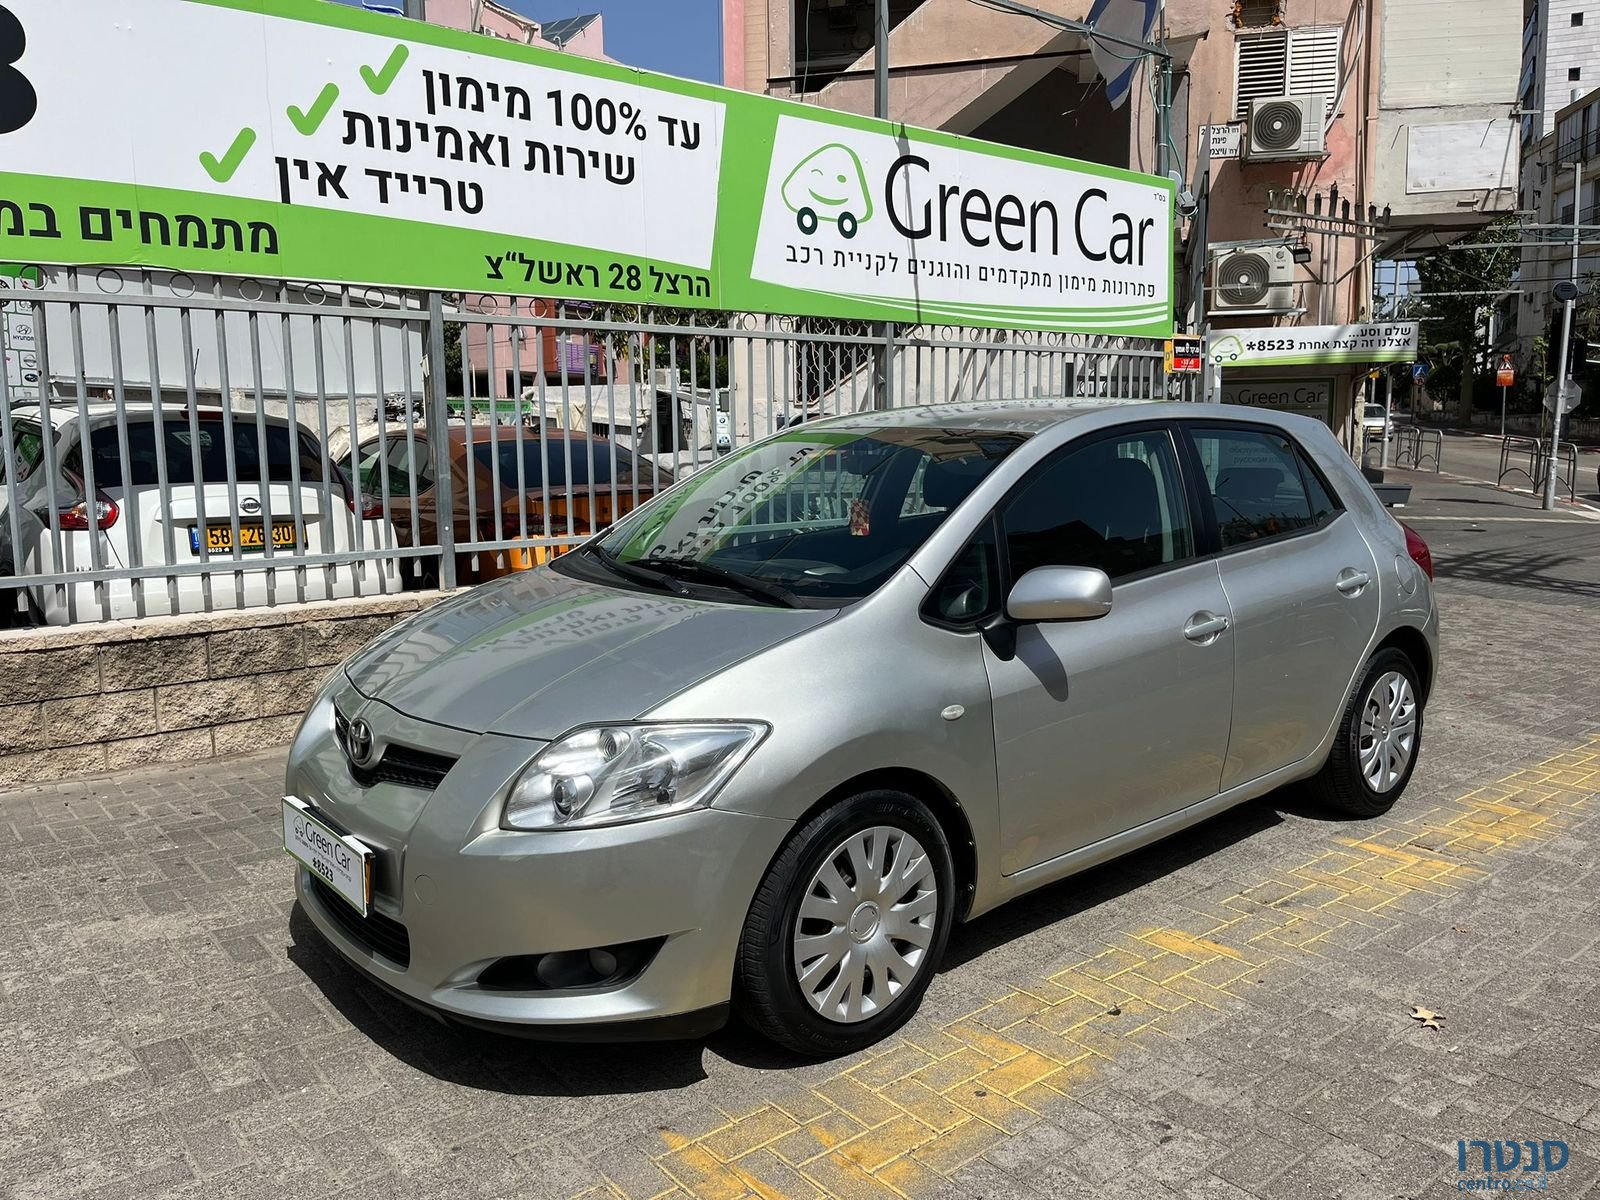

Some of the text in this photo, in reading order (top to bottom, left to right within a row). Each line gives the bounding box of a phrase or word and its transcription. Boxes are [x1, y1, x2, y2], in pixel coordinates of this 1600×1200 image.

[422, 69, 700, 150] עד 100% מימון
[1211, 126, 1230, 135] הרצל
[342, 110, 635, 185] שירות ואמינות
[274, 156, 484, 215] טרייד אין
[885, 154, 1154, 266] Green Car
[79, 206, 279, 255] מתמחים
[608, 262, 642, 292] 28
[649, 265, 711, 298] הרצל
[786, 244, 1155, 298] פתרונות מימון מתקדמים והוגנים לקניית רכב
[1298, 340, 1329, 350] אחרת
[1333, 339, 1357, 351] קצת
[1361, 339, 1374, 348] זה
[1377, 336, 1411, 348] אצלנו
[1384, 326, 1411, 337] שלם
[1238, 387, 1324, 404] Green Car
[305, 821, 334, 859] Green
[334, 843, 351, 872] Car
